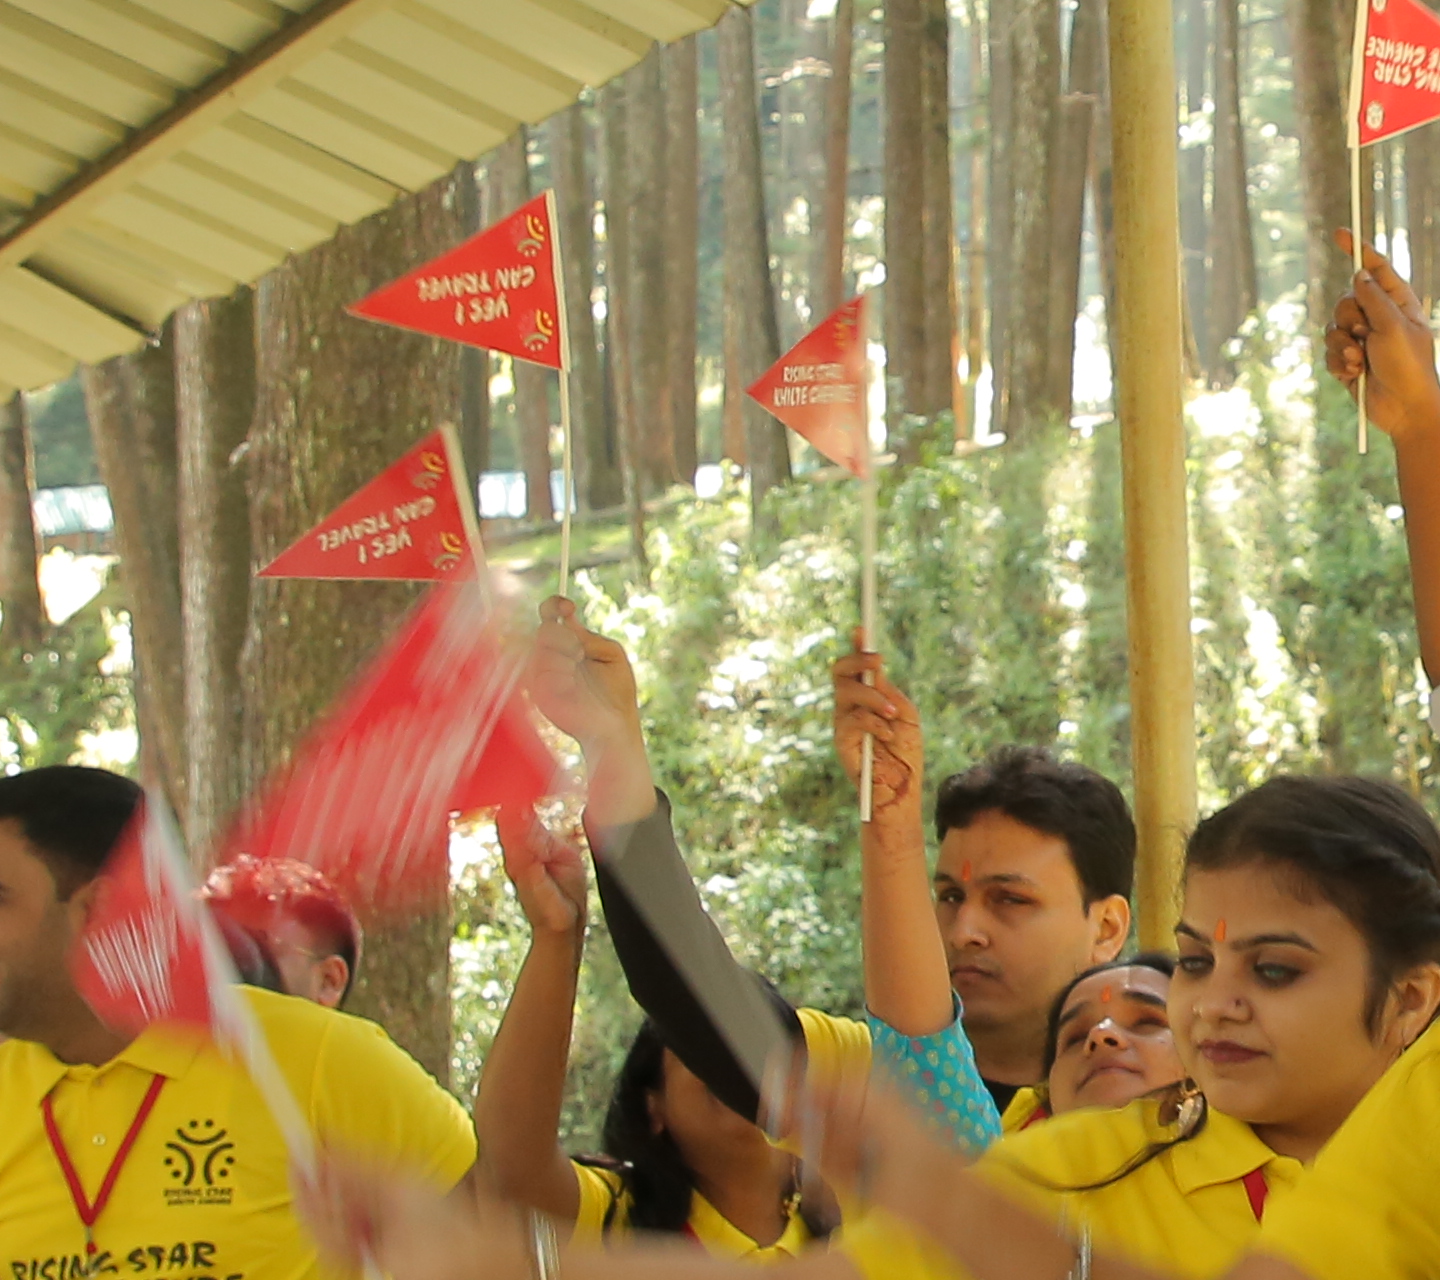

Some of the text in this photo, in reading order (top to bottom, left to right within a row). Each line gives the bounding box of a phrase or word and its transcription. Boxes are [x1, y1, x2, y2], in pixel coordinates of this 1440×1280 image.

[416, 264, 536, 302] CAN TRAVEL
[454, 291, 510, 327] YES I
[317, 495, 437, 552] CAN TRAVEL
[357, 524, 413, 565] YES I
[127, 1241, 217, 1271] STAR
